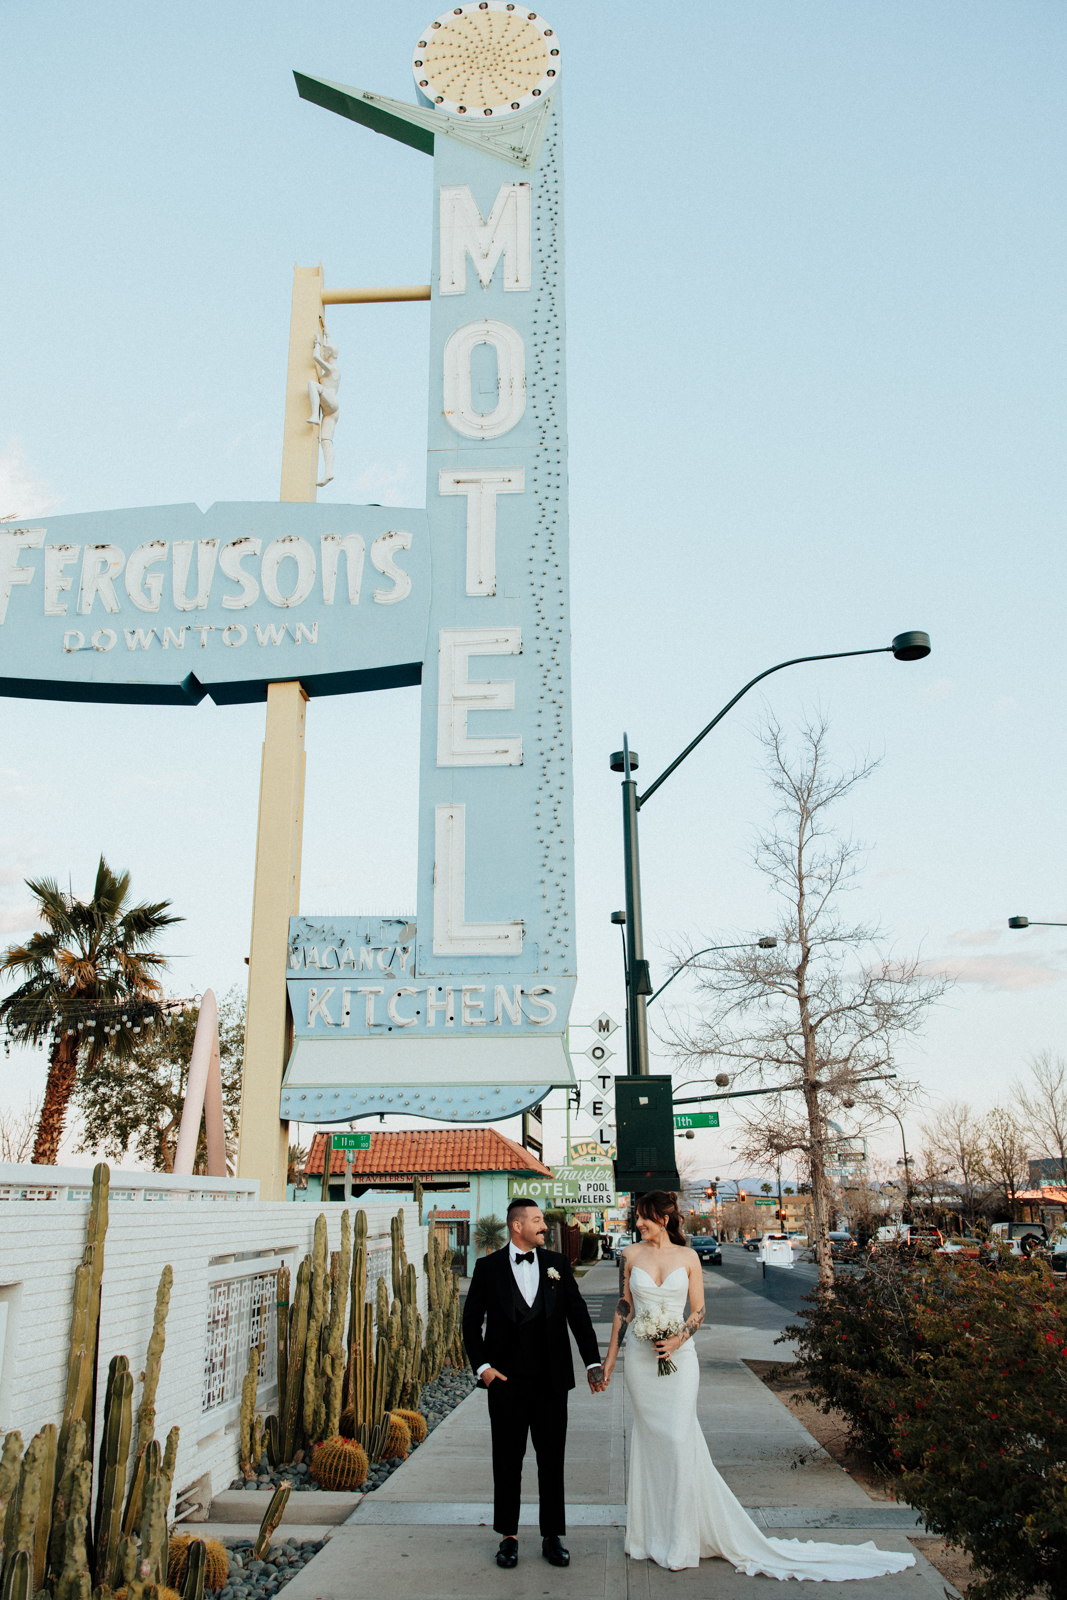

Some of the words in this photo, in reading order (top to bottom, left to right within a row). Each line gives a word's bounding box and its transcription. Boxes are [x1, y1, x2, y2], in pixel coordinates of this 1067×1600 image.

[433, 181, 532, 956] MOTEL
[63, 622, 319, 654] DOWNTOWN
[288, 945, 412, 971] VACANCY
[307, 984, 557, 1029] KITCHENS
[592, 1019, 610, 1144] MOTEL
[341, 1137, 354, 1146] 11th
[571, 1143, 616, 1159] LUCKY
[353, 1175, 404, 1183] TRAVELERS
[406, 1174, 435, 1182] MTEL
[513, 1182, 574, 1196] MOTEL
[586, 1183, 609, 1191] POOL
